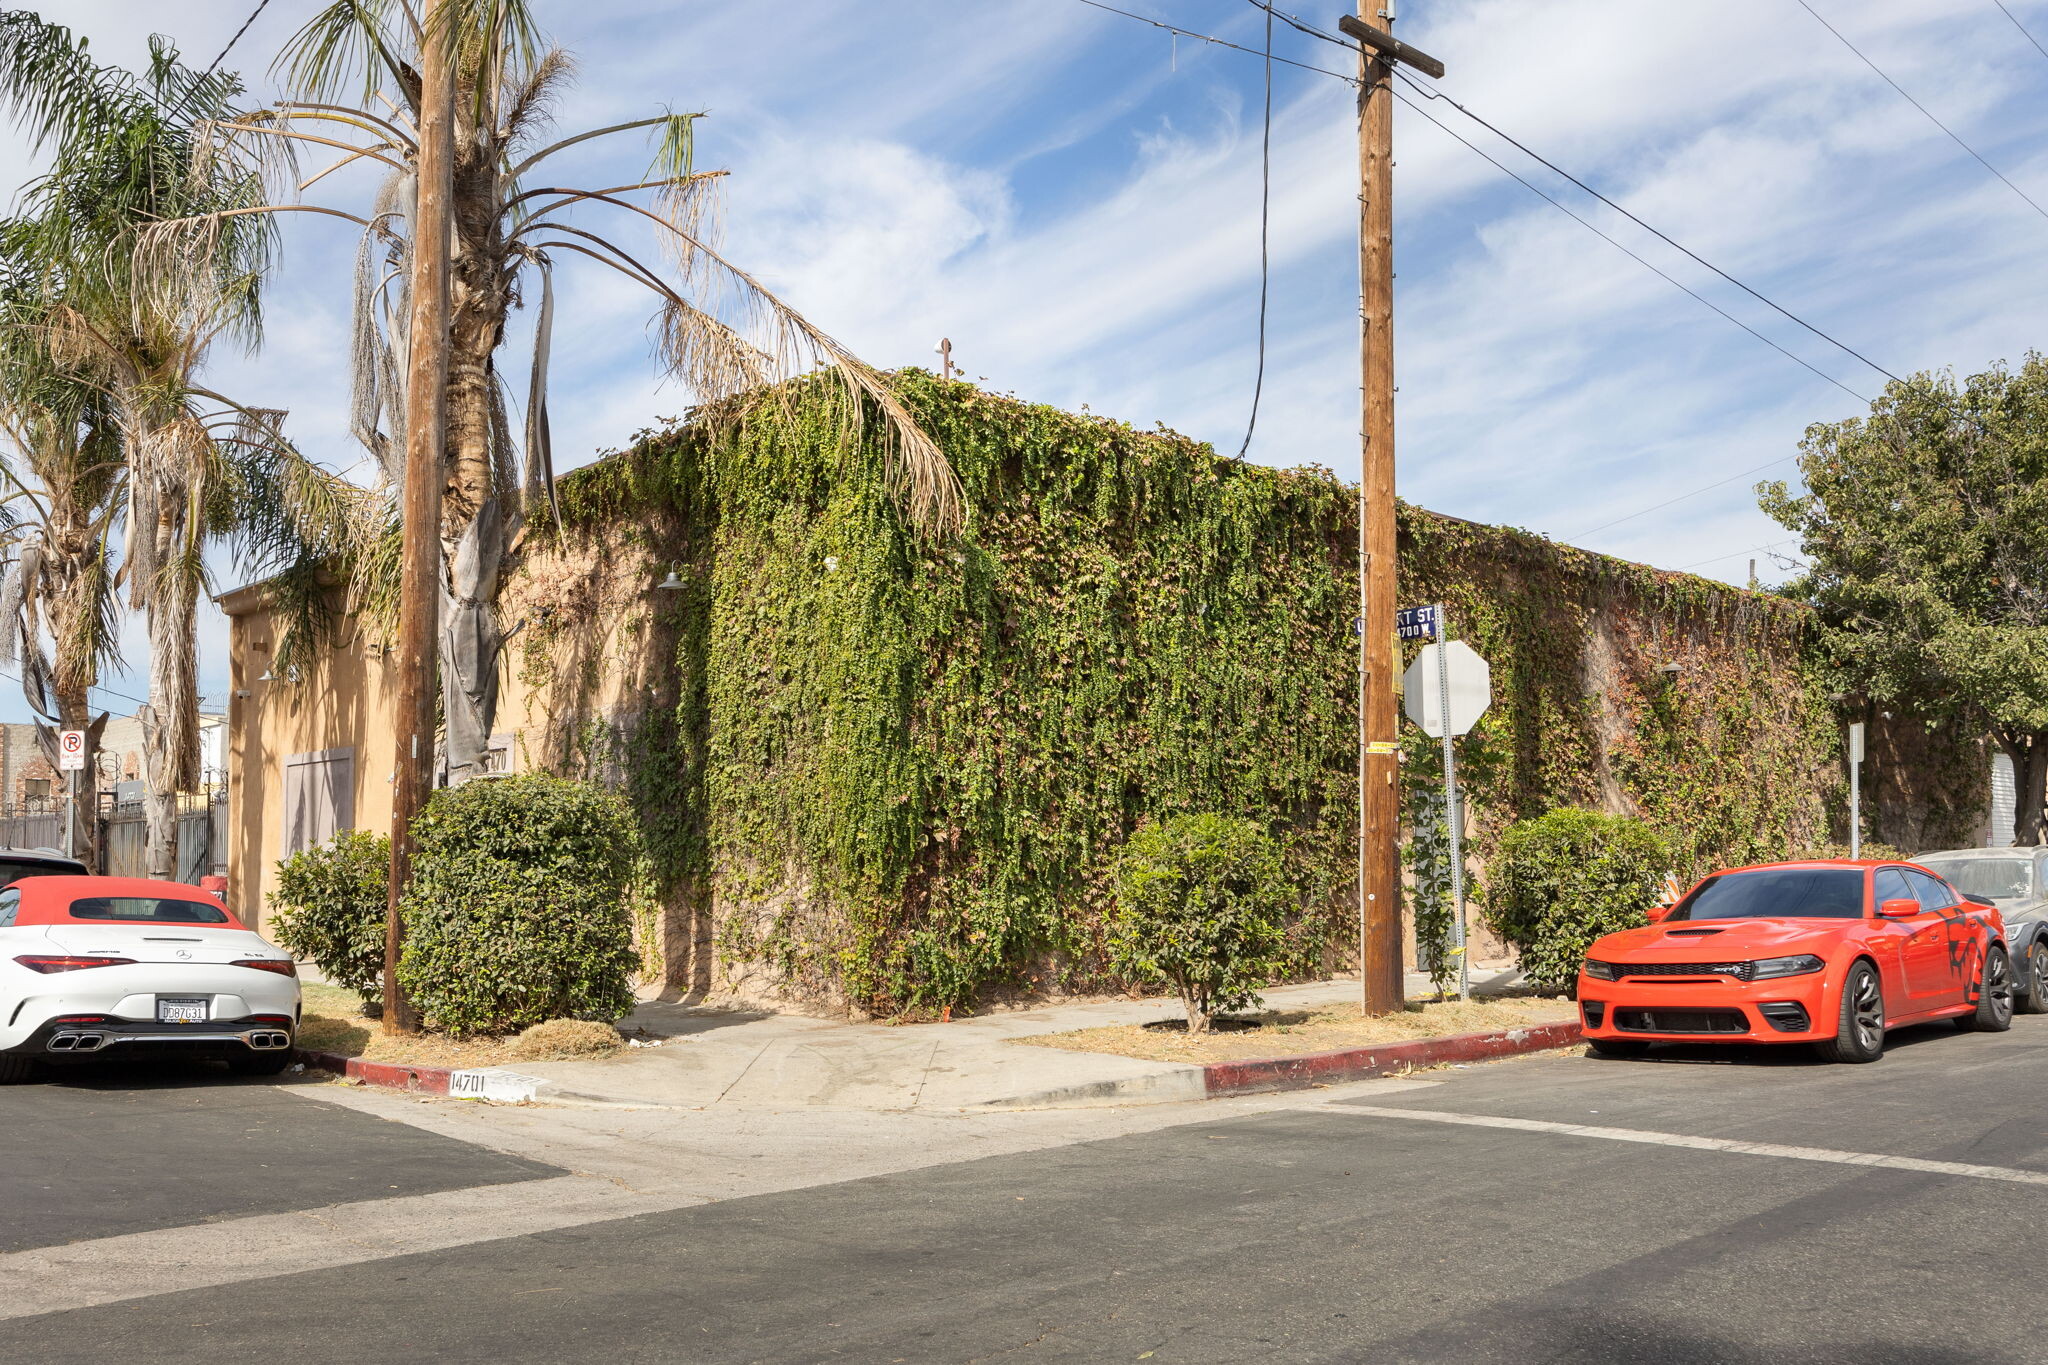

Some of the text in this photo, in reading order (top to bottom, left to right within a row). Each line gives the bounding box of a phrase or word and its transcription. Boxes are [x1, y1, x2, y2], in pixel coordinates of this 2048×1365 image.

[1417, 607, 1435, 623] ST.
[163, 1007, 203, 1019] DD87G31
[451, 1073, 485, 1092] 14701
